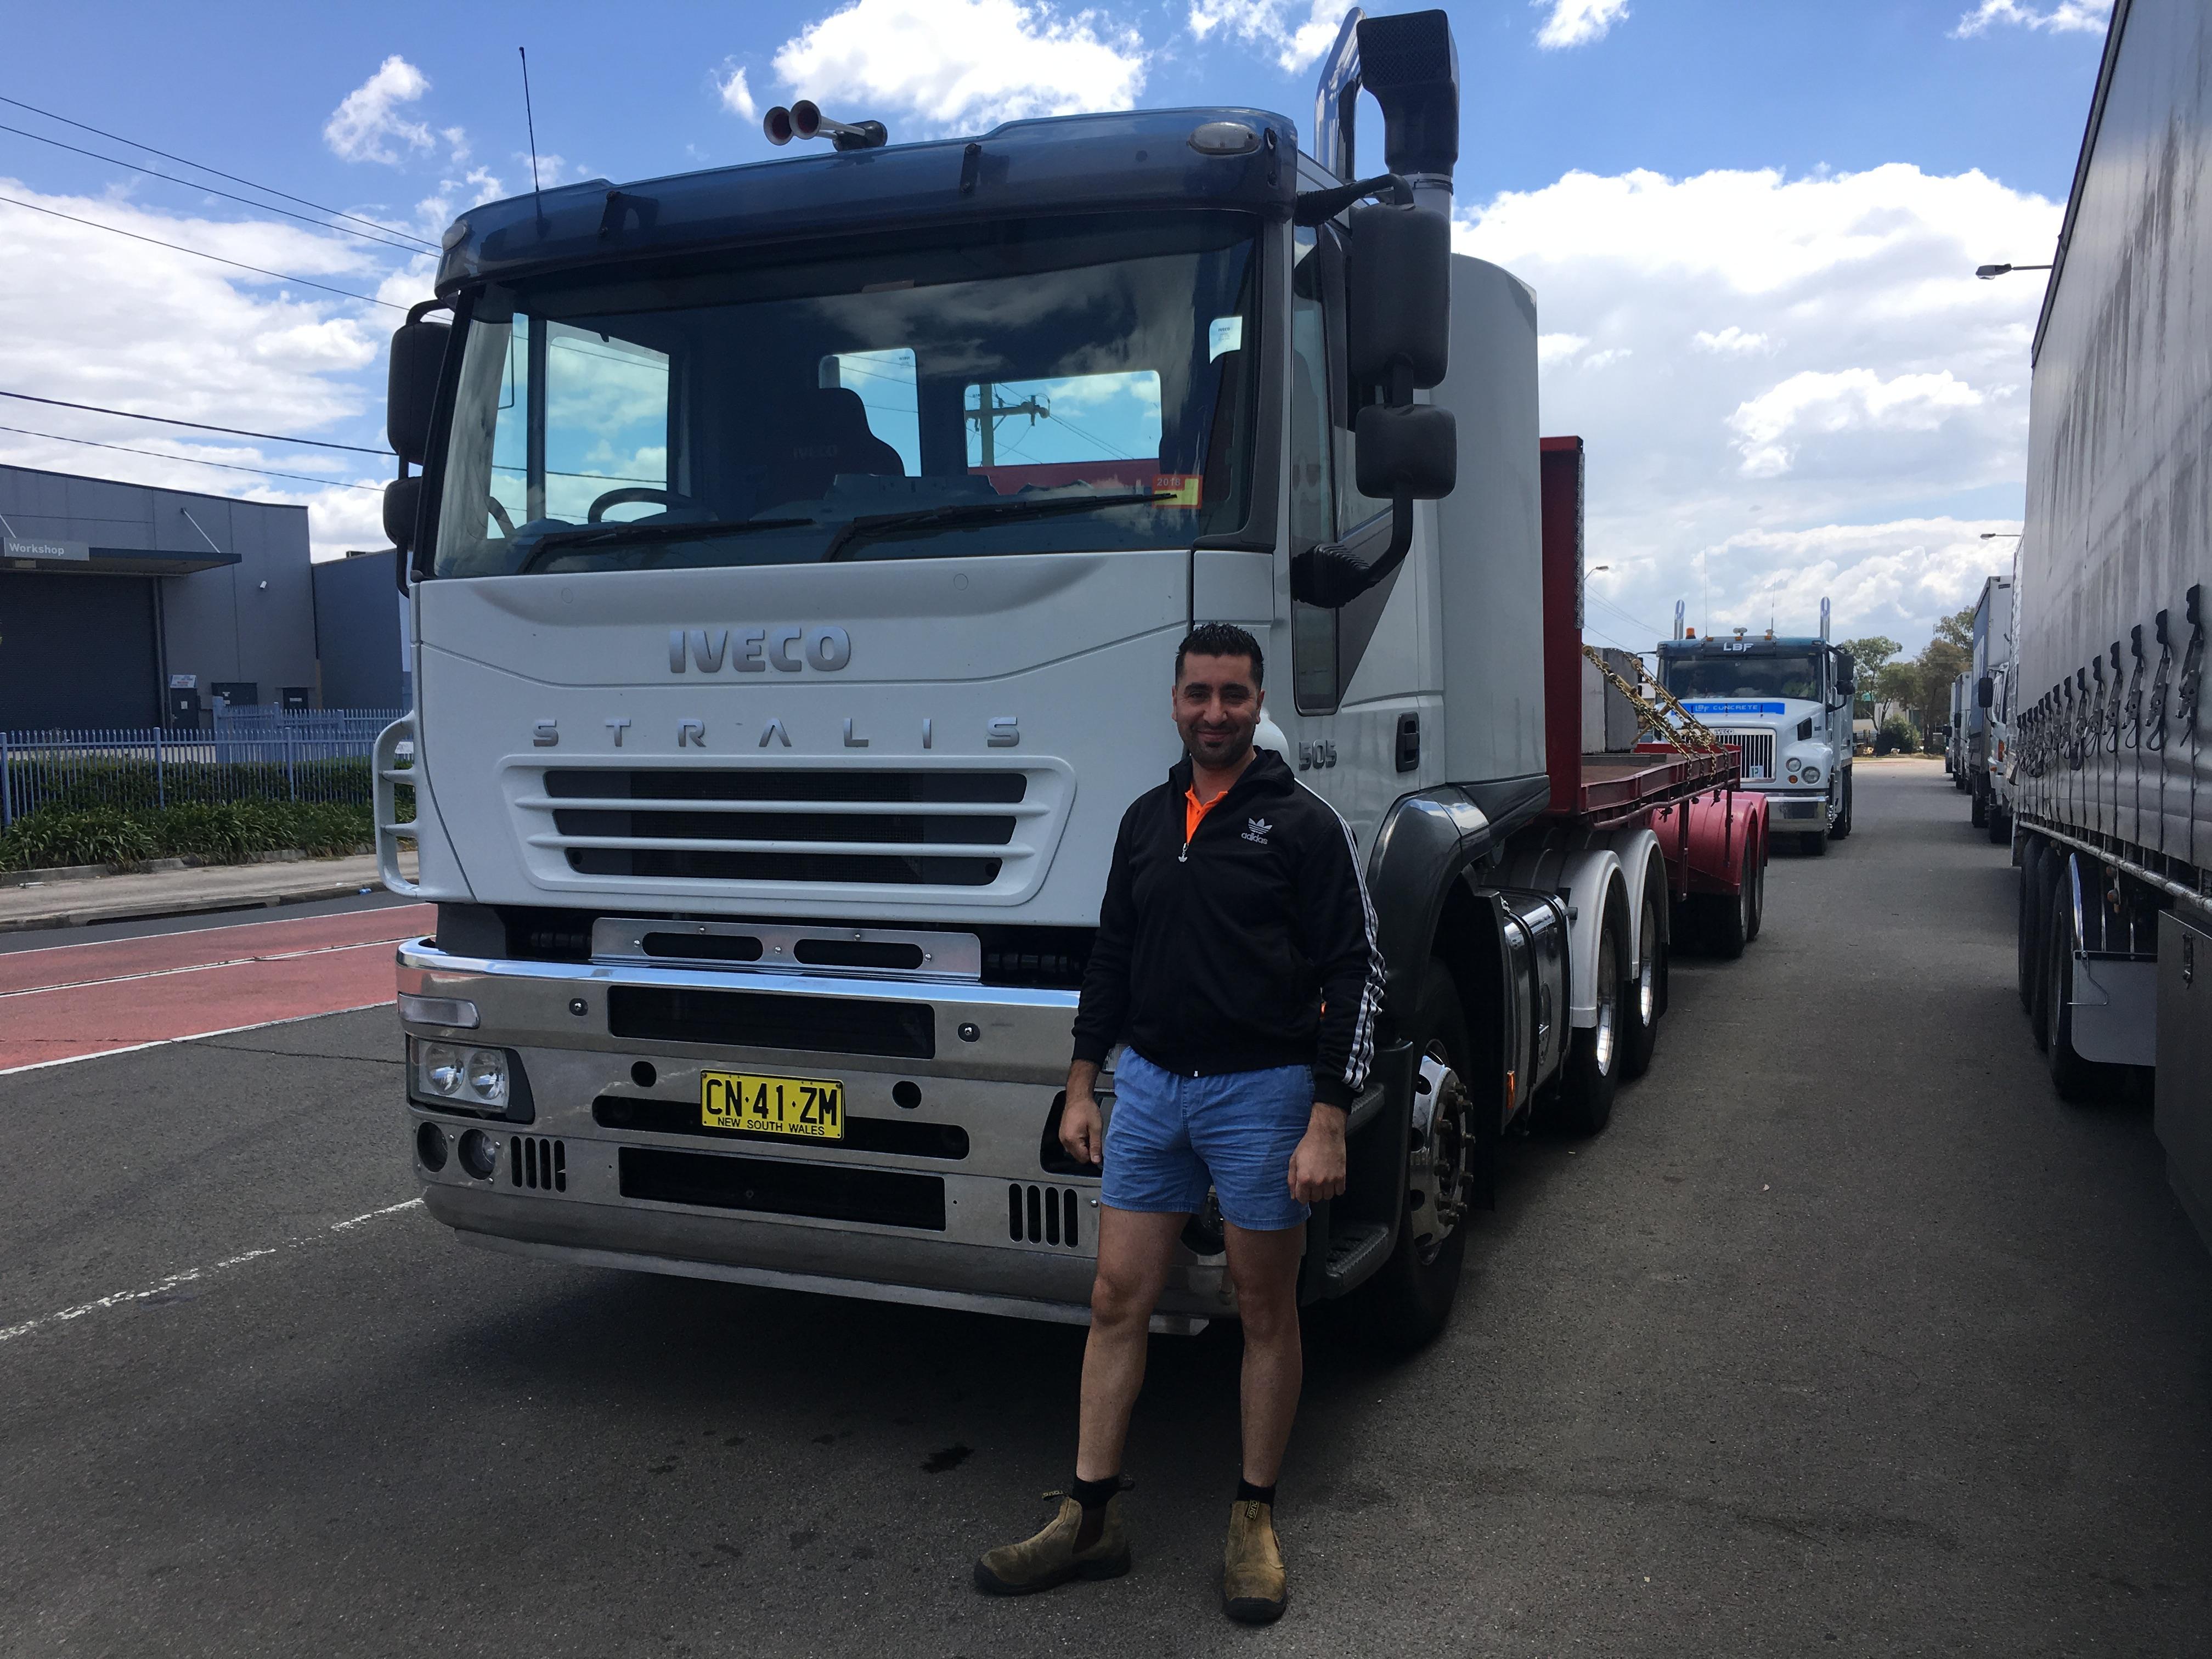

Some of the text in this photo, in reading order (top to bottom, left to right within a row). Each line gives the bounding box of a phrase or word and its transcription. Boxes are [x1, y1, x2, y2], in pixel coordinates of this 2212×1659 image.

[1156, 477, 1181, 487] 2018
[9, 543, 65, 556] Workshop
[668, 626, 852, 674] IVECO
[1723, 641, 1754, 652] LBF
[532, 716, 1020, 748] STRALIS
[1299, 739, 1338, 771] 505
[1241, 832, 1268, 845] adidas
[718, 1117, 825, 1136] NEW SOUTH WALES
